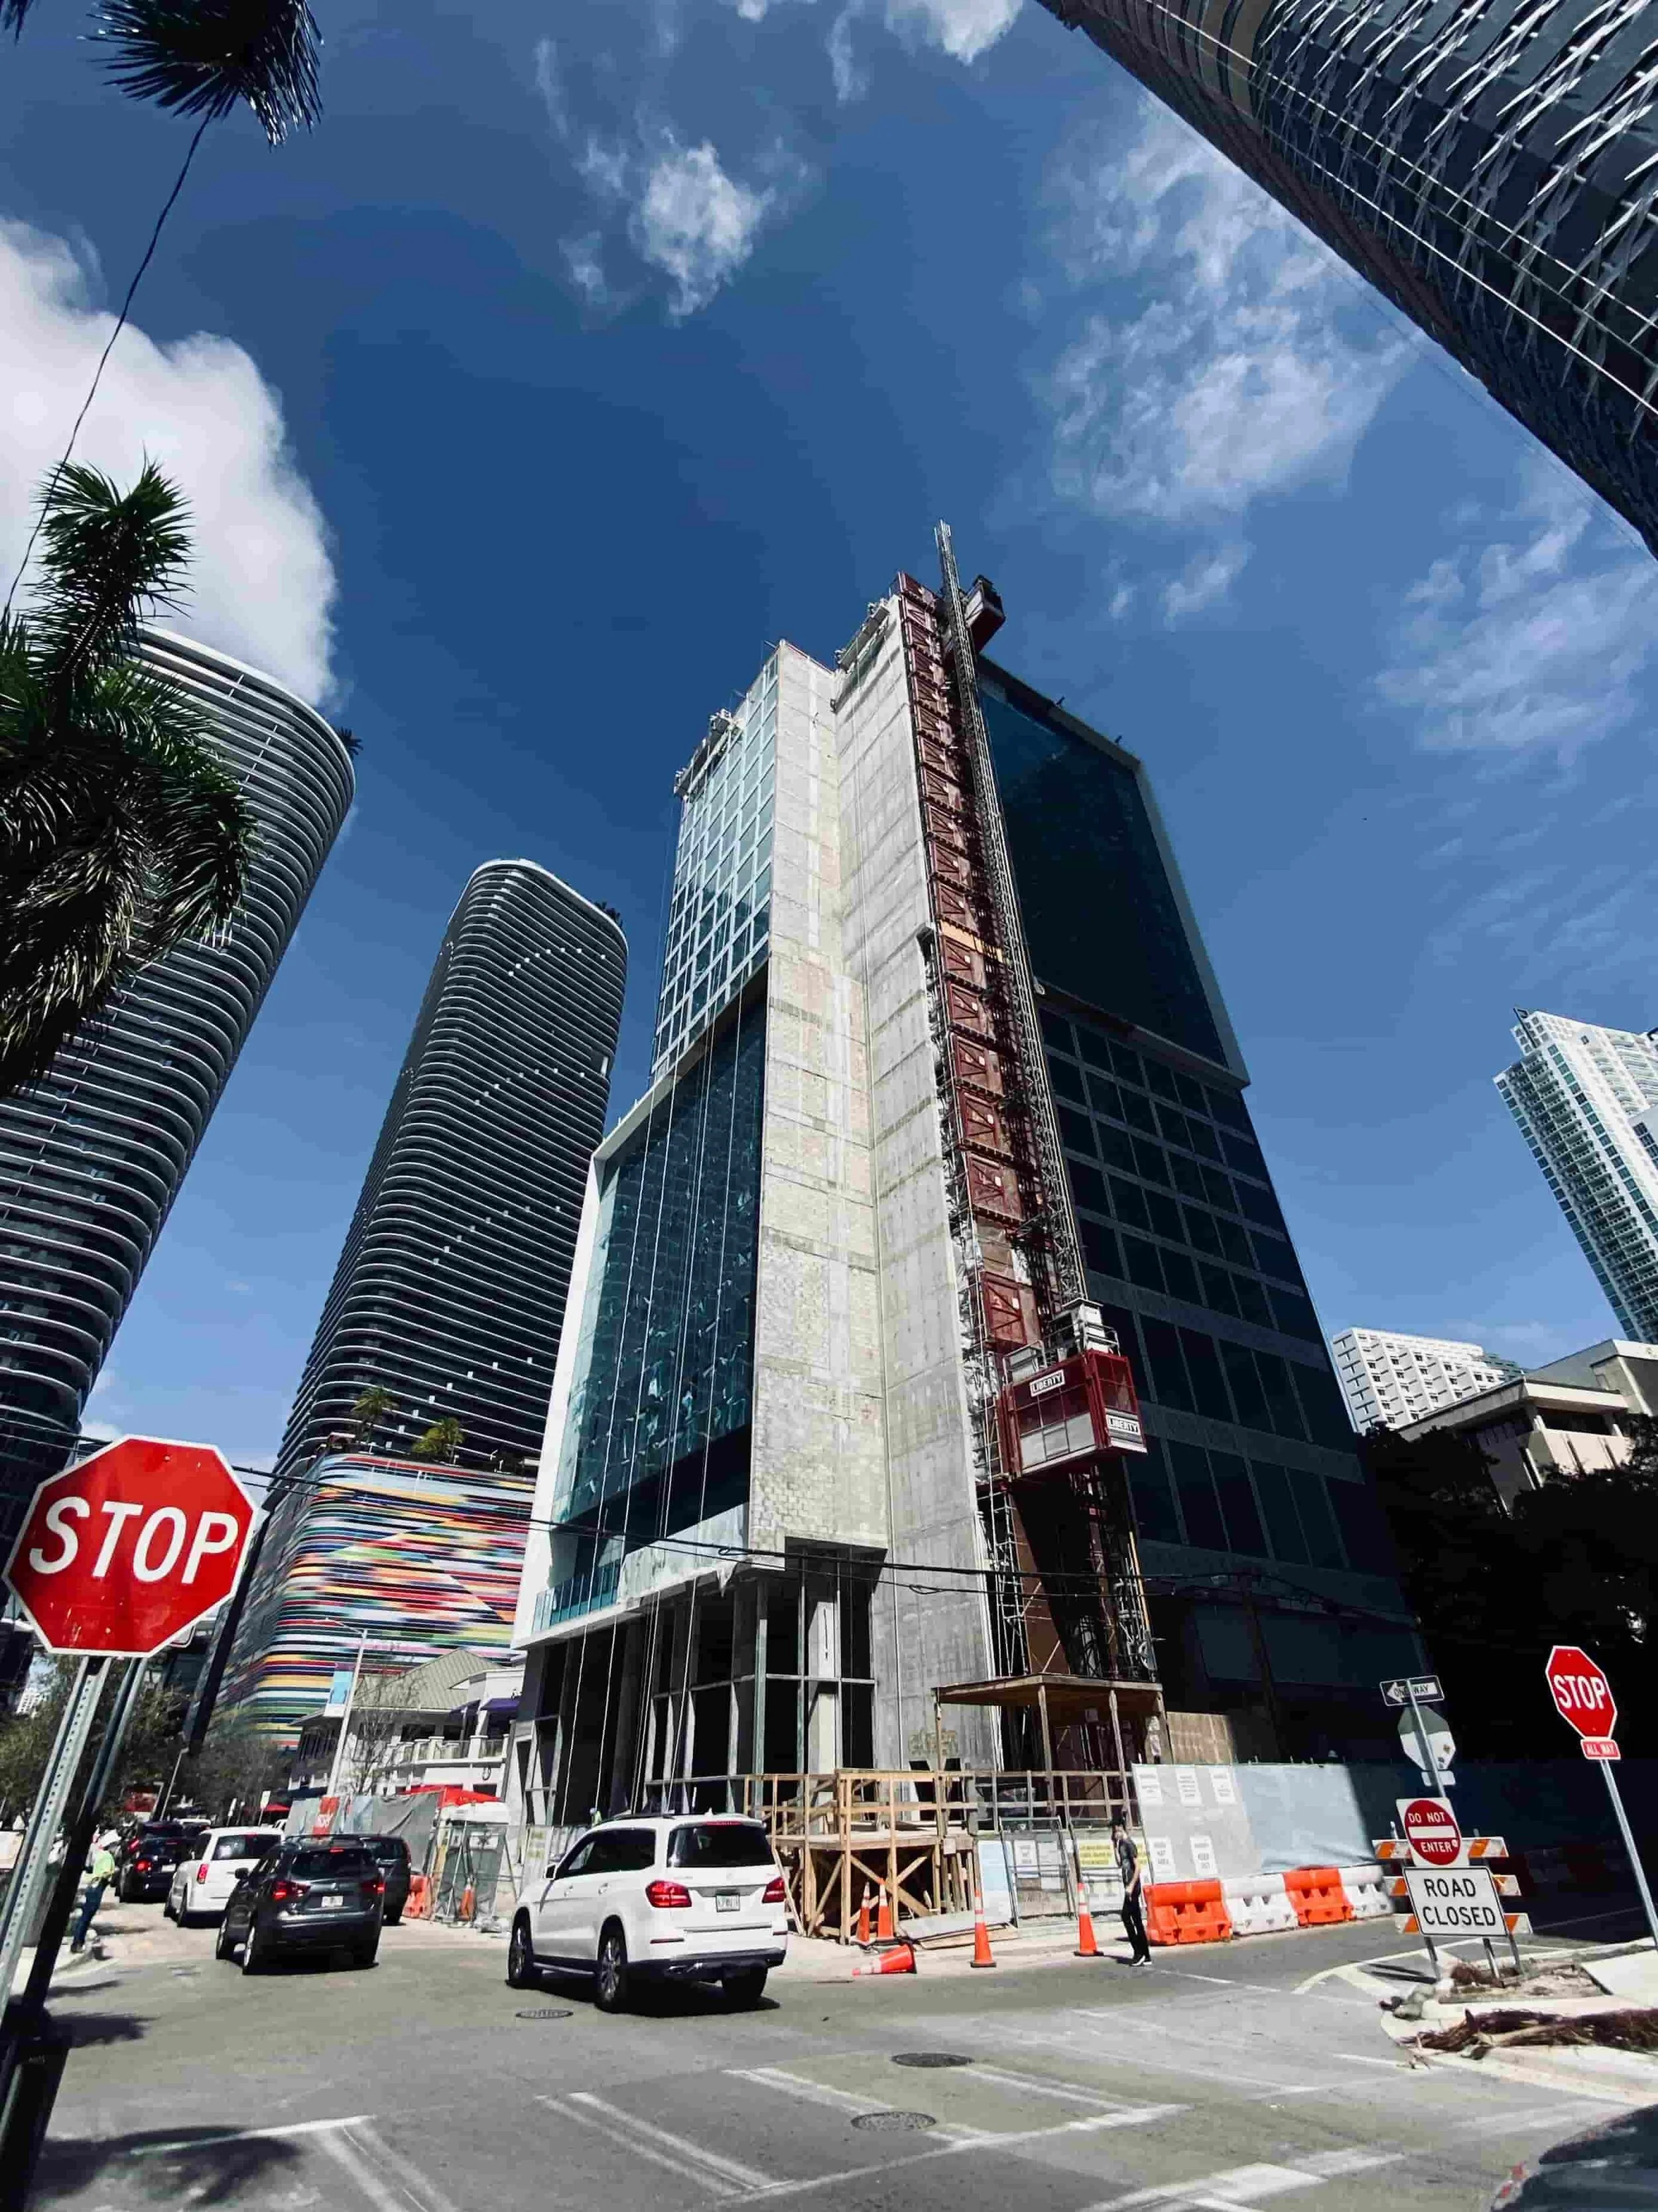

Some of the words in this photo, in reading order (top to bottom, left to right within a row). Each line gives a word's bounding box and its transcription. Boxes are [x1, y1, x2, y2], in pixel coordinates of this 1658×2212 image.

[1032, 1374, 1062, 1392] LIBERTY
[1109, 1418, 1138, 1432] LIBERTY
[29, 1496, 238, 1584] STOP
[1413, 1685, 1429, 1694] WAY
[1553, 1675, 1605, 1710] STOP
[1586, 1744, 1598, 1754] ALL
[1600, 1744, 1615, 1754] WAY
[1407, 1813, 1421, 1823] DO
[1427, 1812, 1445, 1823] NOT
[1420, 1842, 1452, 1853] ENTER
[1424, 1878, 1476, 1898] ROAD
[1423, 1906, 1496, 1926] CLOSED
